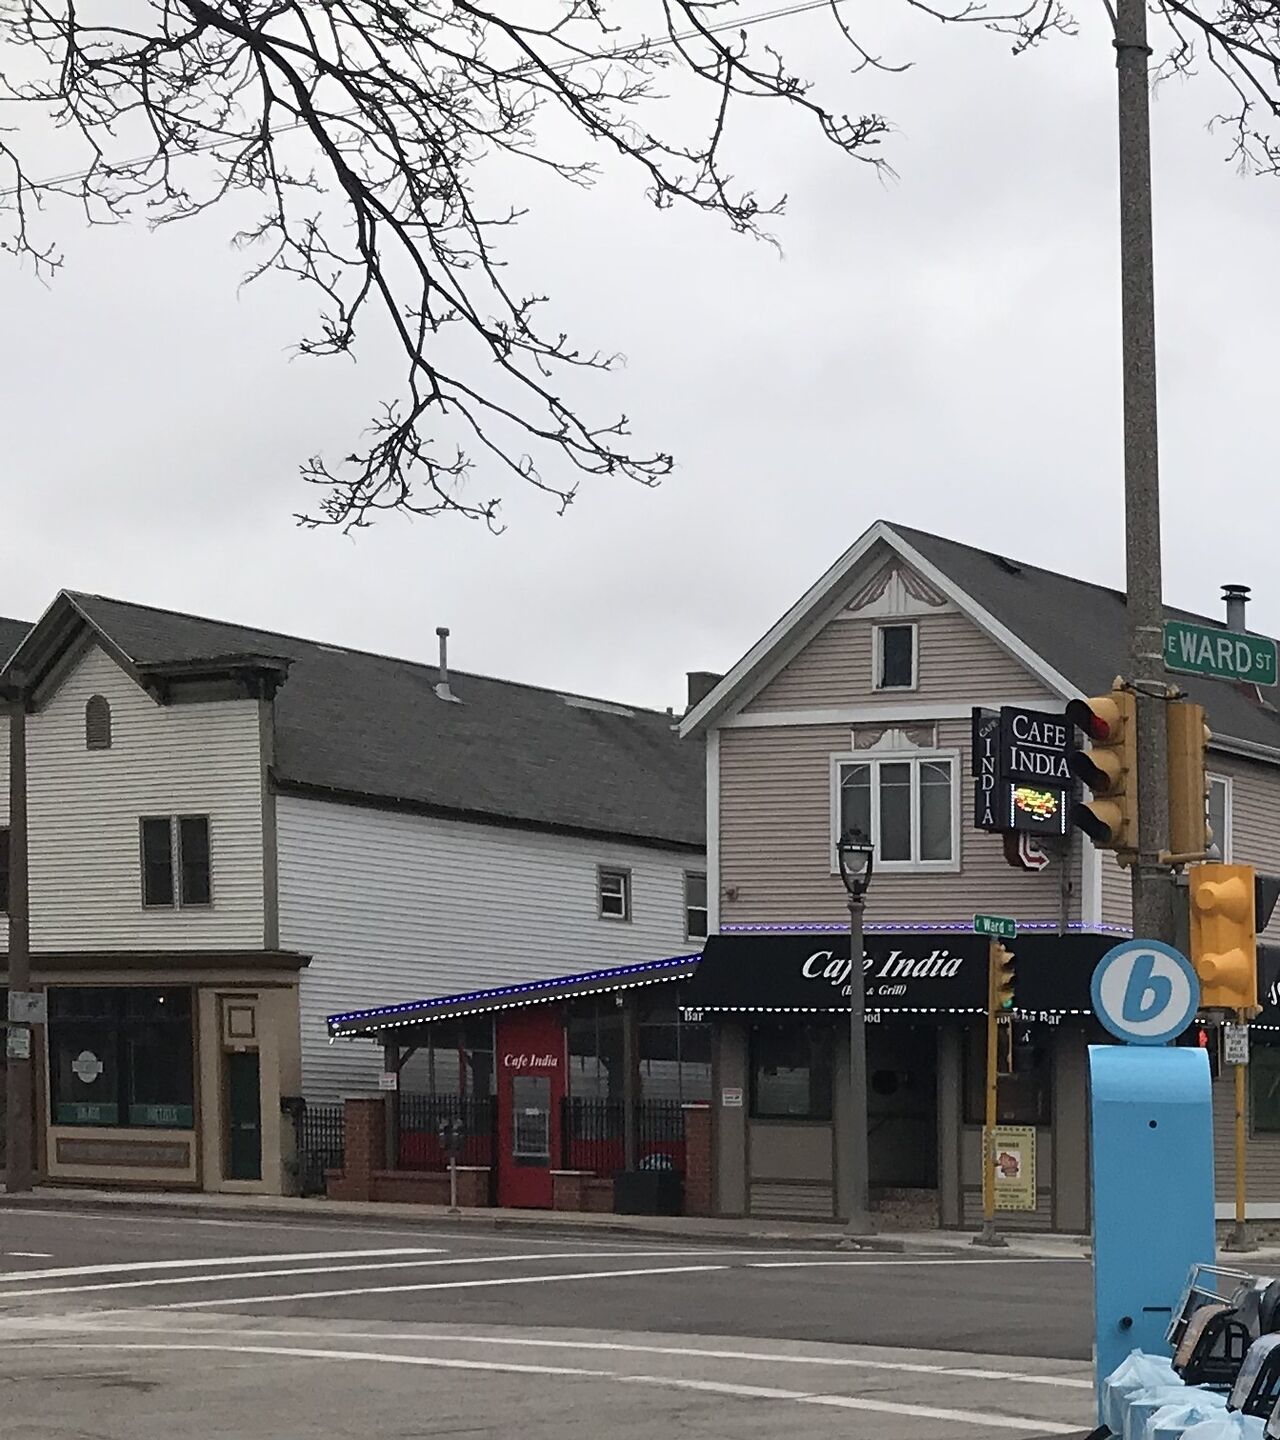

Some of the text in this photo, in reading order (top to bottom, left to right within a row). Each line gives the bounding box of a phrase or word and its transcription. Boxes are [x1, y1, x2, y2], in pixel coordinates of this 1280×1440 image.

[1168, 630, 1272, 673] E WARD ST
[1012, 715, 1067, 747] CAFE
[1010, 746, 1071, 779] INDIA
[981, 738, 995, 824] INDIA
[983, 918, 1005, 934] Ward
[875, 950, 964, 978] India
[684, 1010, 704, 1022] Bar
[504, 1053, 558, 1070] Cafe India
